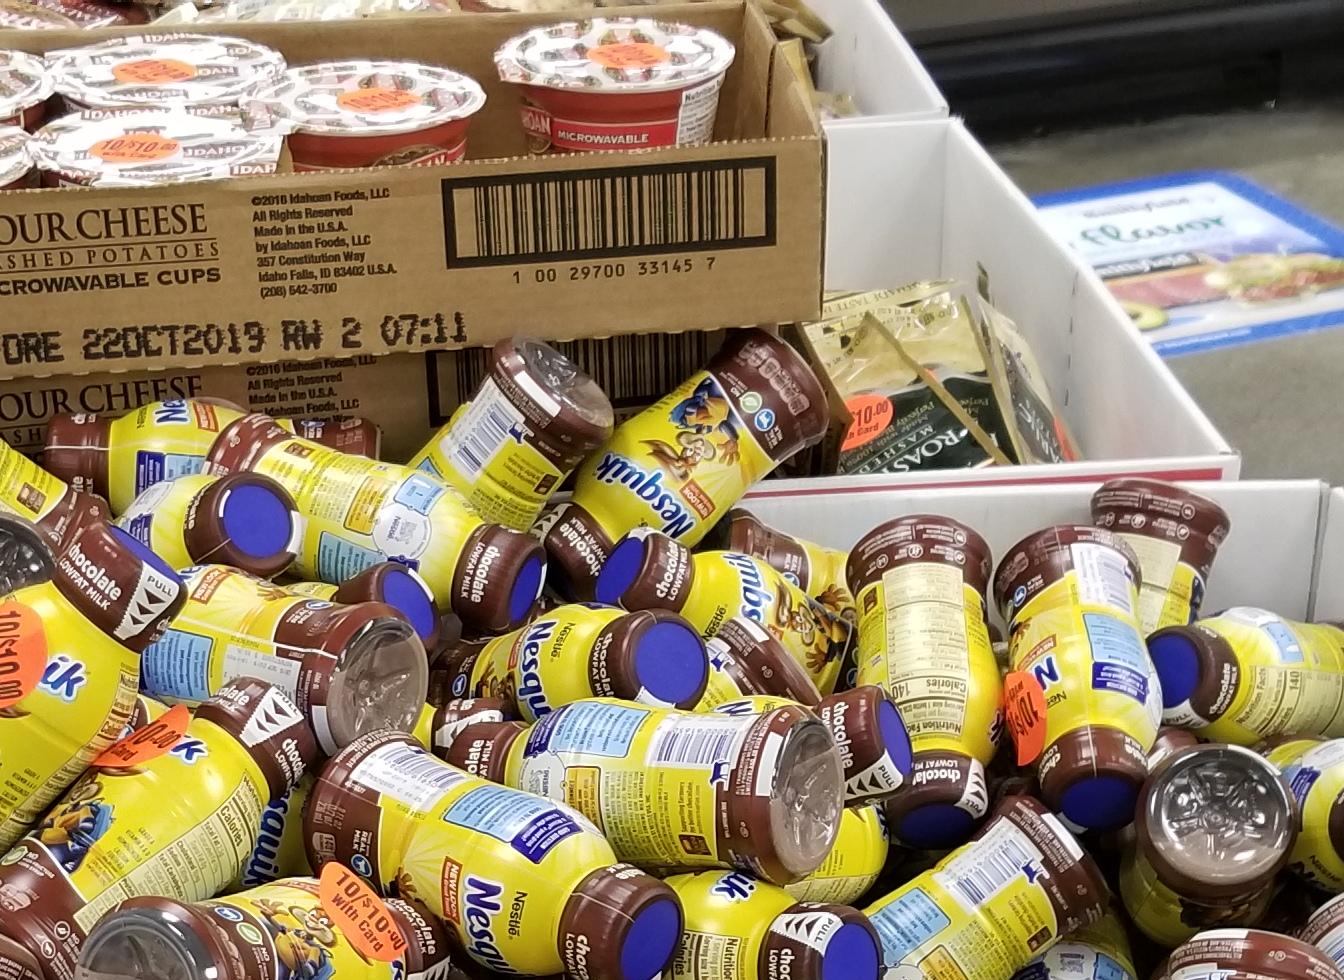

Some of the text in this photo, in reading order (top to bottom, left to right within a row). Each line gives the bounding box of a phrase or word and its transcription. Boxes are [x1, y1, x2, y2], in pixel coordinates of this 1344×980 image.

[557, 130, 649, 145] MICROWAVABLE
[370, 187, 390, 199] LLC
[76, 203, 208, 241] CHEESE
[252, 205, 354, 222] All Rights Reserved
[254, 226, 283, 237] Made
[298, 223, 315, 235] the
[317, 221, 348, 233] U.S.A.
[87, 241, 220, 264] POTATOES
[271, 238, 313, 252] Idahoan
[315, 236, 349, 249] Foods,
[352, 235, 371, 246] LLC
[257, 251, 365, 267] 357 Constitution Way
[512, 256, 716, 286] 1 00 29700 33145 7
[157, 267, 221, 286] CUPS
[258, 270, 288, 283] Idaho
[290, 269, 318, 280] Falls,
[320, 268, 331, 279] ID
[367, 263, 397, 275] U.S.A.
[281, 319, 323, 351] RW
[341, 317, 362, 349] 2
[379, 311, 468, 346] 07:11
[596, 452, 695, 540] Nesquik
[59, 557, 111, 611] LOWFAT MILK
[68, 543, 122, 601] chocolate
[460, 542, 486, 599] LOWFAT MILK
[471, 545, 500, 603] chocolate
[147, 575, 174, 597] PULL
[926, 679, 966, 692] Calories
[1289, 671, 1300, 690] 140
[833, 701, 855, 769] chocolate
[923, 720, 962, 734] Nutrition
[877, 765, 895, 788] PULL
[219, 805, 244, 847] Calories
[330, 892, 384, 953] with Card
[336, 870, 407, 952] 10/$10.00
[507, 890, 528, 938] Nestlé
[815, 916, 834, 943] PULL
[674, 933, 689, 976] Calories
